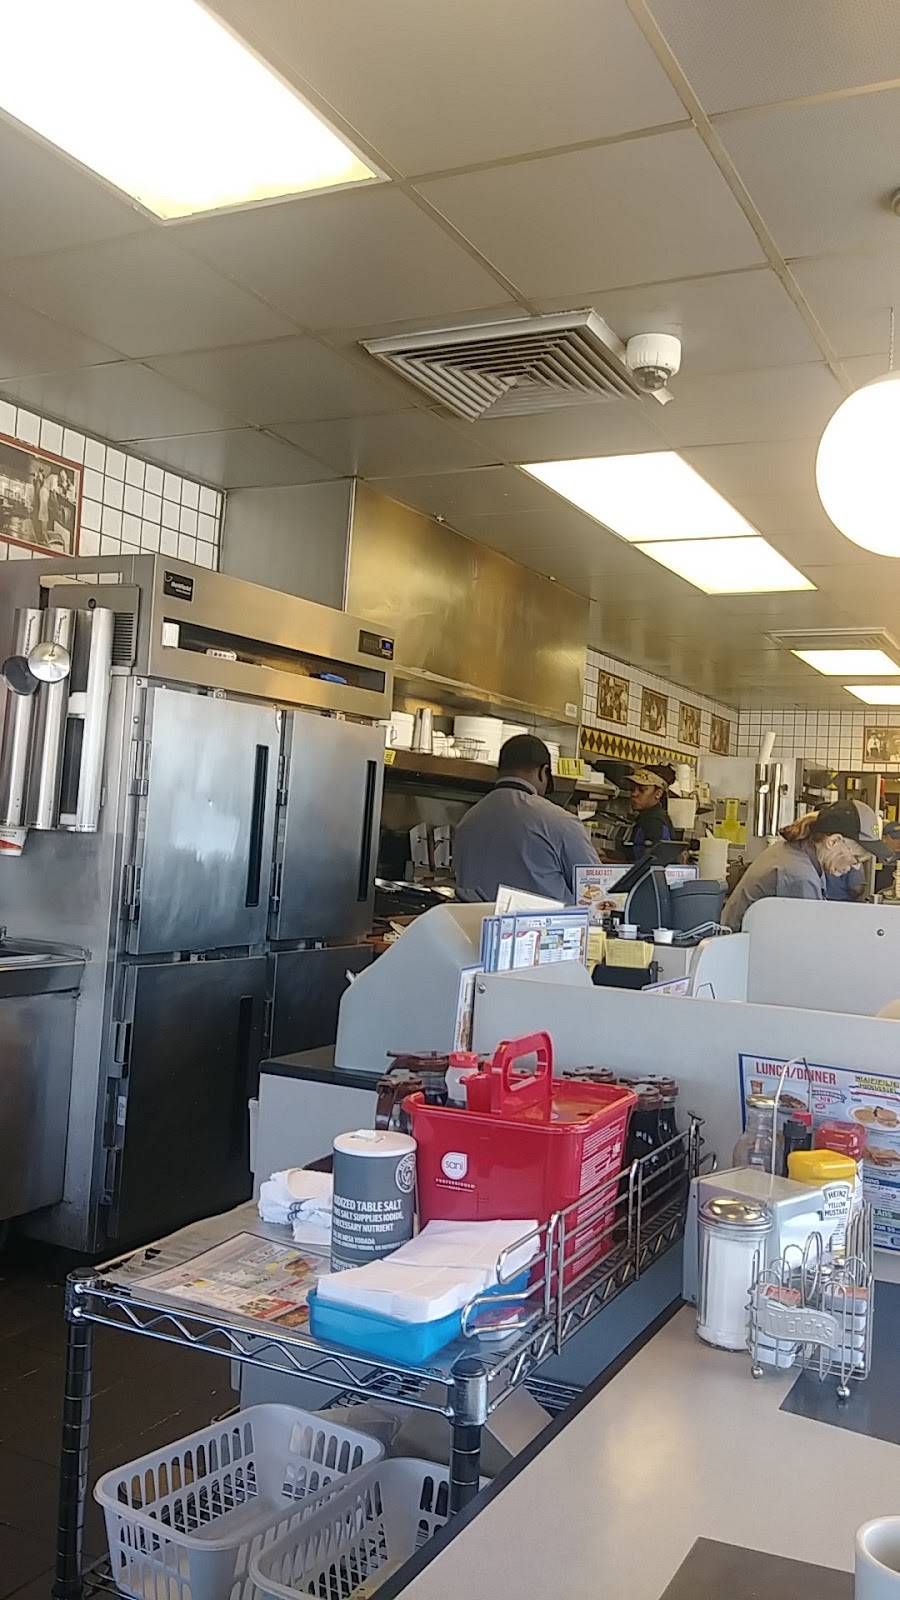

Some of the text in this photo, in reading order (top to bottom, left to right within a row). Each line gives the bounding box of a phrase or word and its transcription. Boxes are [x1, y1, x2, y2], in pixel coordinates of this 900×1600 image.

[755, 1061, 837, 1085] LUNCH/DINNER
[828, 1190, 847, 1199] HEINZ
[357, 1200, 383, 1212] TABLE
[383, 1199, 402, 1211] SALT
[353, 1213, 383, 1222] SUPPLIES
[362, 1223, 394, 1232] NUTRIENT
